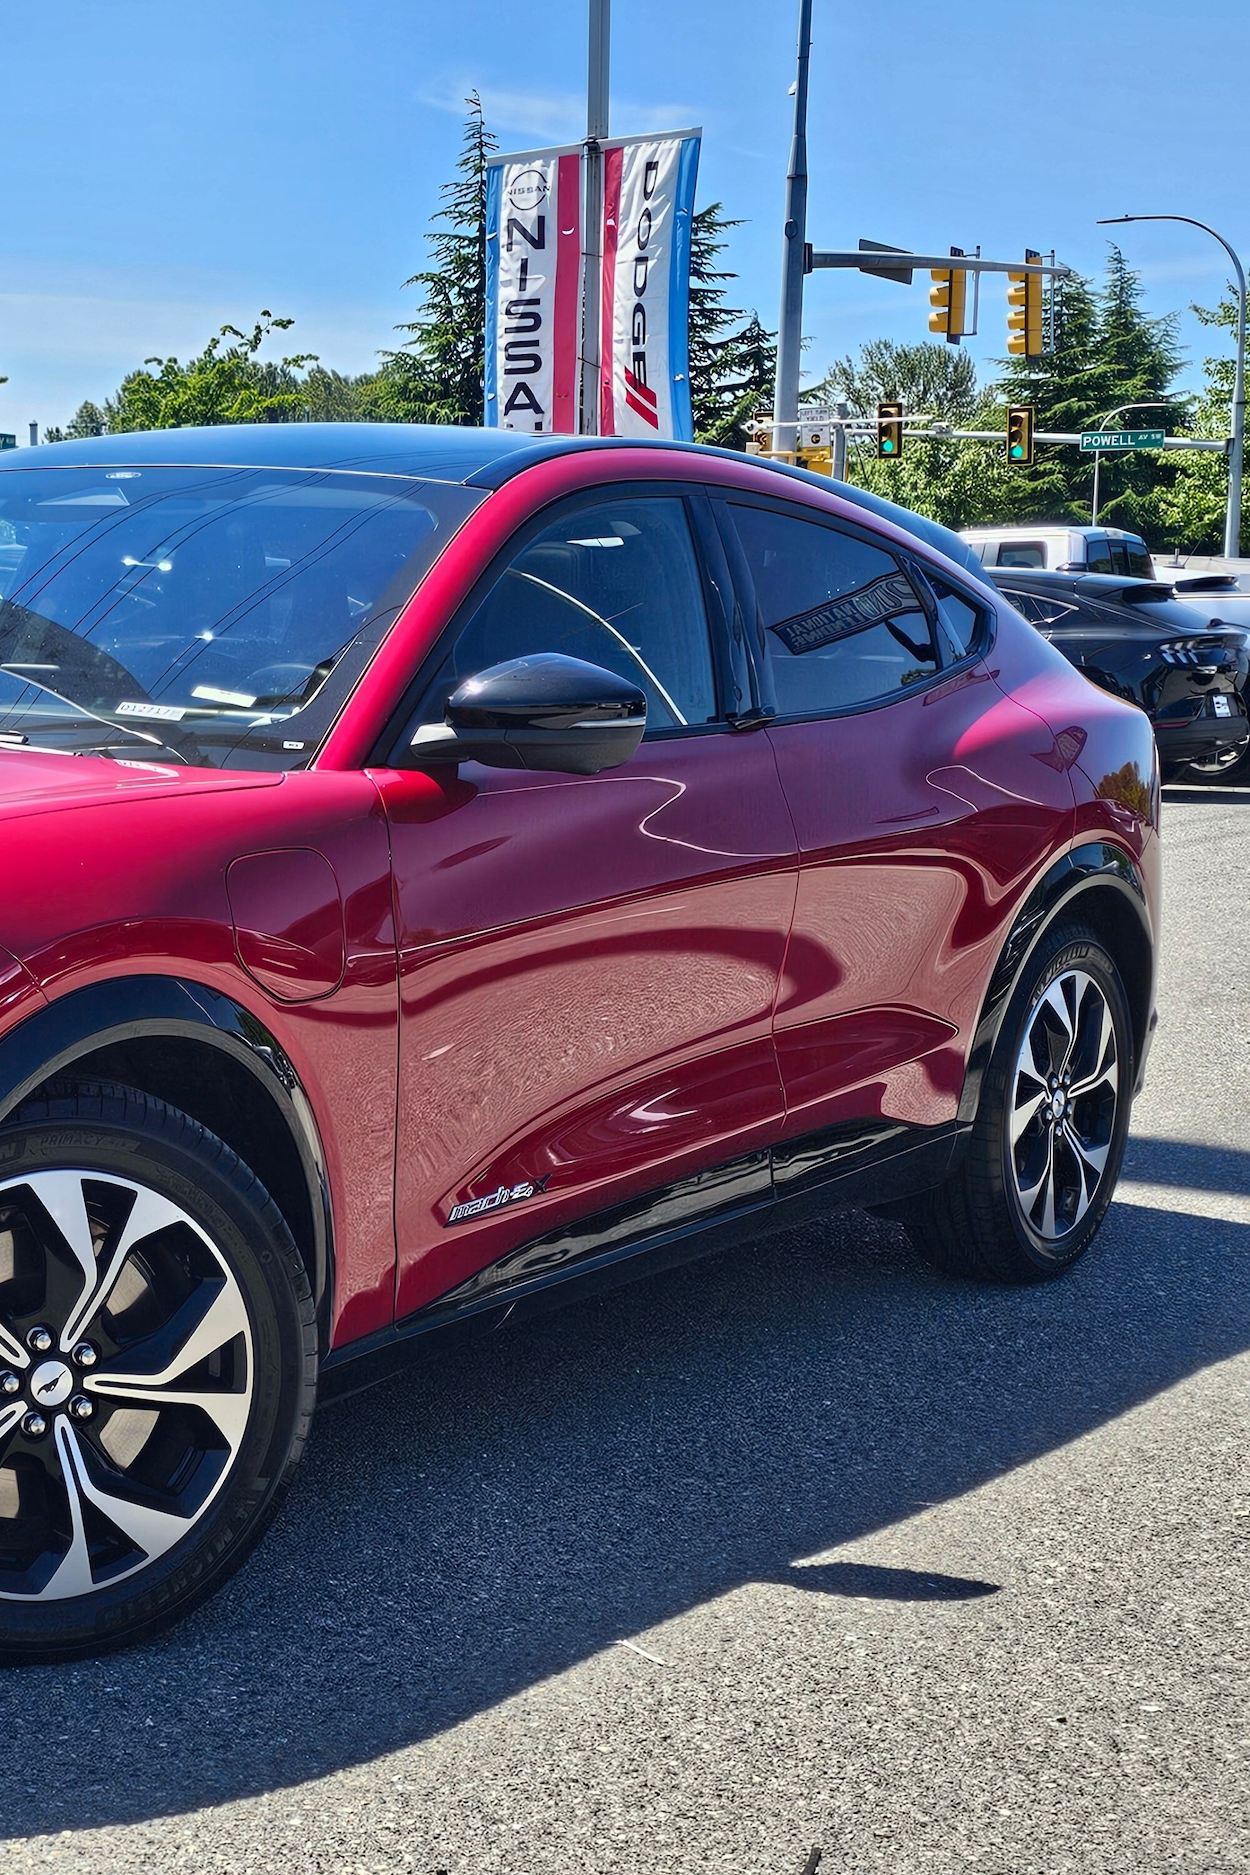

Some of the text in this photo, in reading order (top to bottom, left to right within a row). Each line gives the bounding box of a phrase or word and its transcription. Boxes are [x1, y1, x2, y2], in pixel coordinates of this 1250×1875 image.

[507, 185, 550, 195] NISSAN
[632, 160, 659, 389] DODGE
[504, 215, 546, 431] NISSA
[1083, 434, 1136, 447] POWELL
[40, 1134, 104, 1147] PRIMACY
